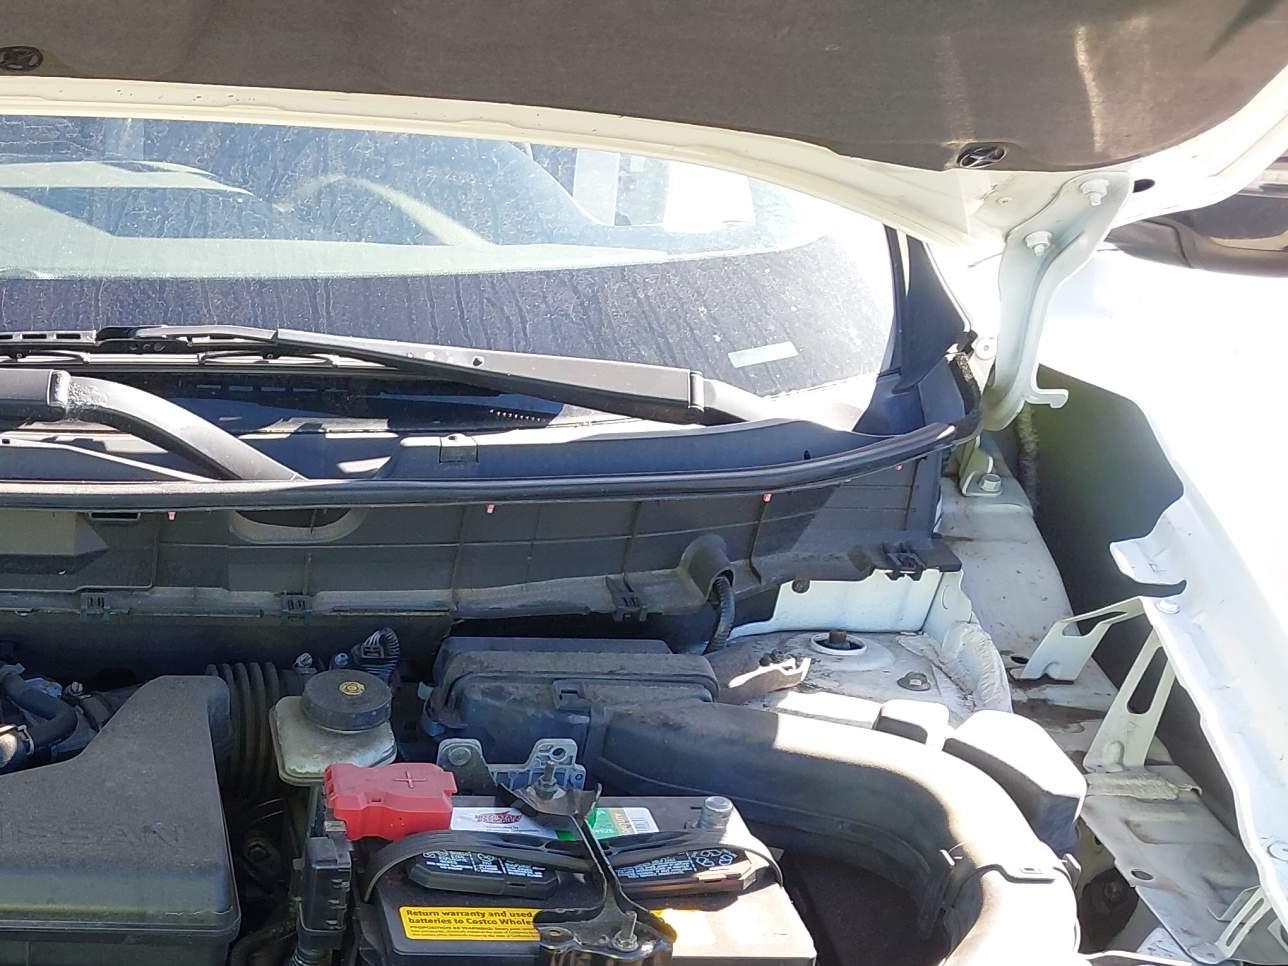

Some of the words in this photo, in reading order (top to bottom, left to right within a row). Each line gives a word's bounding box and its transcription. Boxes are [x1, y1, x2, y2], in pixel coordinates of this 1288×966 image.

[406, 909, 440, 917] Return
[441, 911, 486, 919] warranty
[408, 916, 452, 924] batteries
